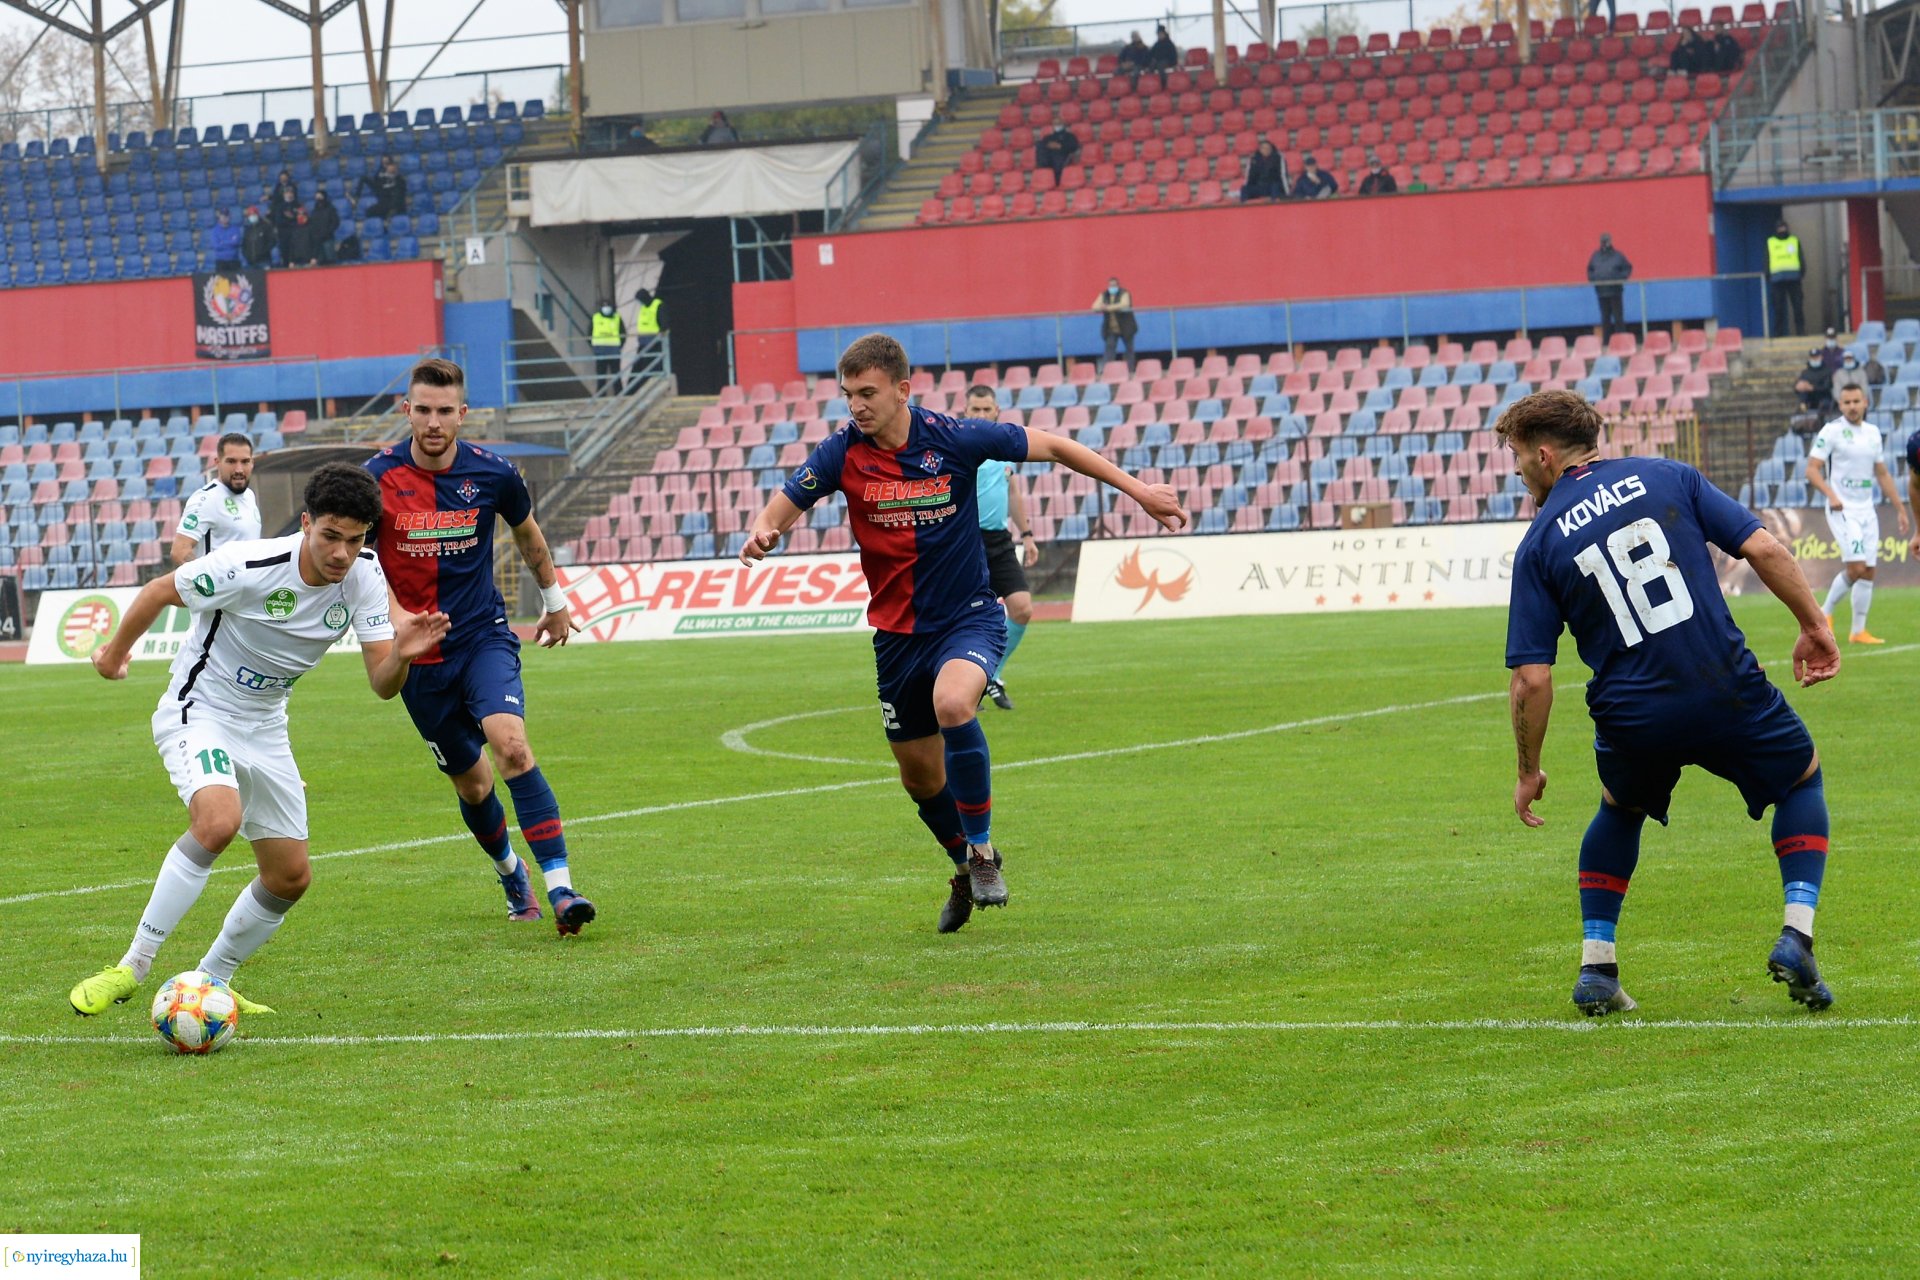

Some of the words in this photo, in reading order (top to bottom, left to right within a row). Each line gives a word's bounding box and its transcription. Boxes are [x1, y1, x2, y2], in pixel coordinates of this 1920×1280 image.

[471, 248, 480, 260] A
[196, 323, 268, 346] MASTIFFS
[916, 504, 957, 520] TRANS
[1556, 475, 1647, 538] KOVÁCS
[443, 536, 478, 551] TRANS
[1332, 536, 1432, 551] HOTEL
[1238, 551, 1516, 590] AVENTINUS
[1573, 517, 1694, 648] 18
[678, 617, 734, 631] ALWAYS
[734, 616, 755, 628] ON
[757, 614, 783, 627] THE
[783, 613, 826, 626] RIGHT
[827, 611, 860, 625] WAY
[967, 650, 988, 664] JAKO
[505, 694, 520, 705] JAKO
[194, 748, 232, 775] 18
[142, 921, 165, 936] JAKO
